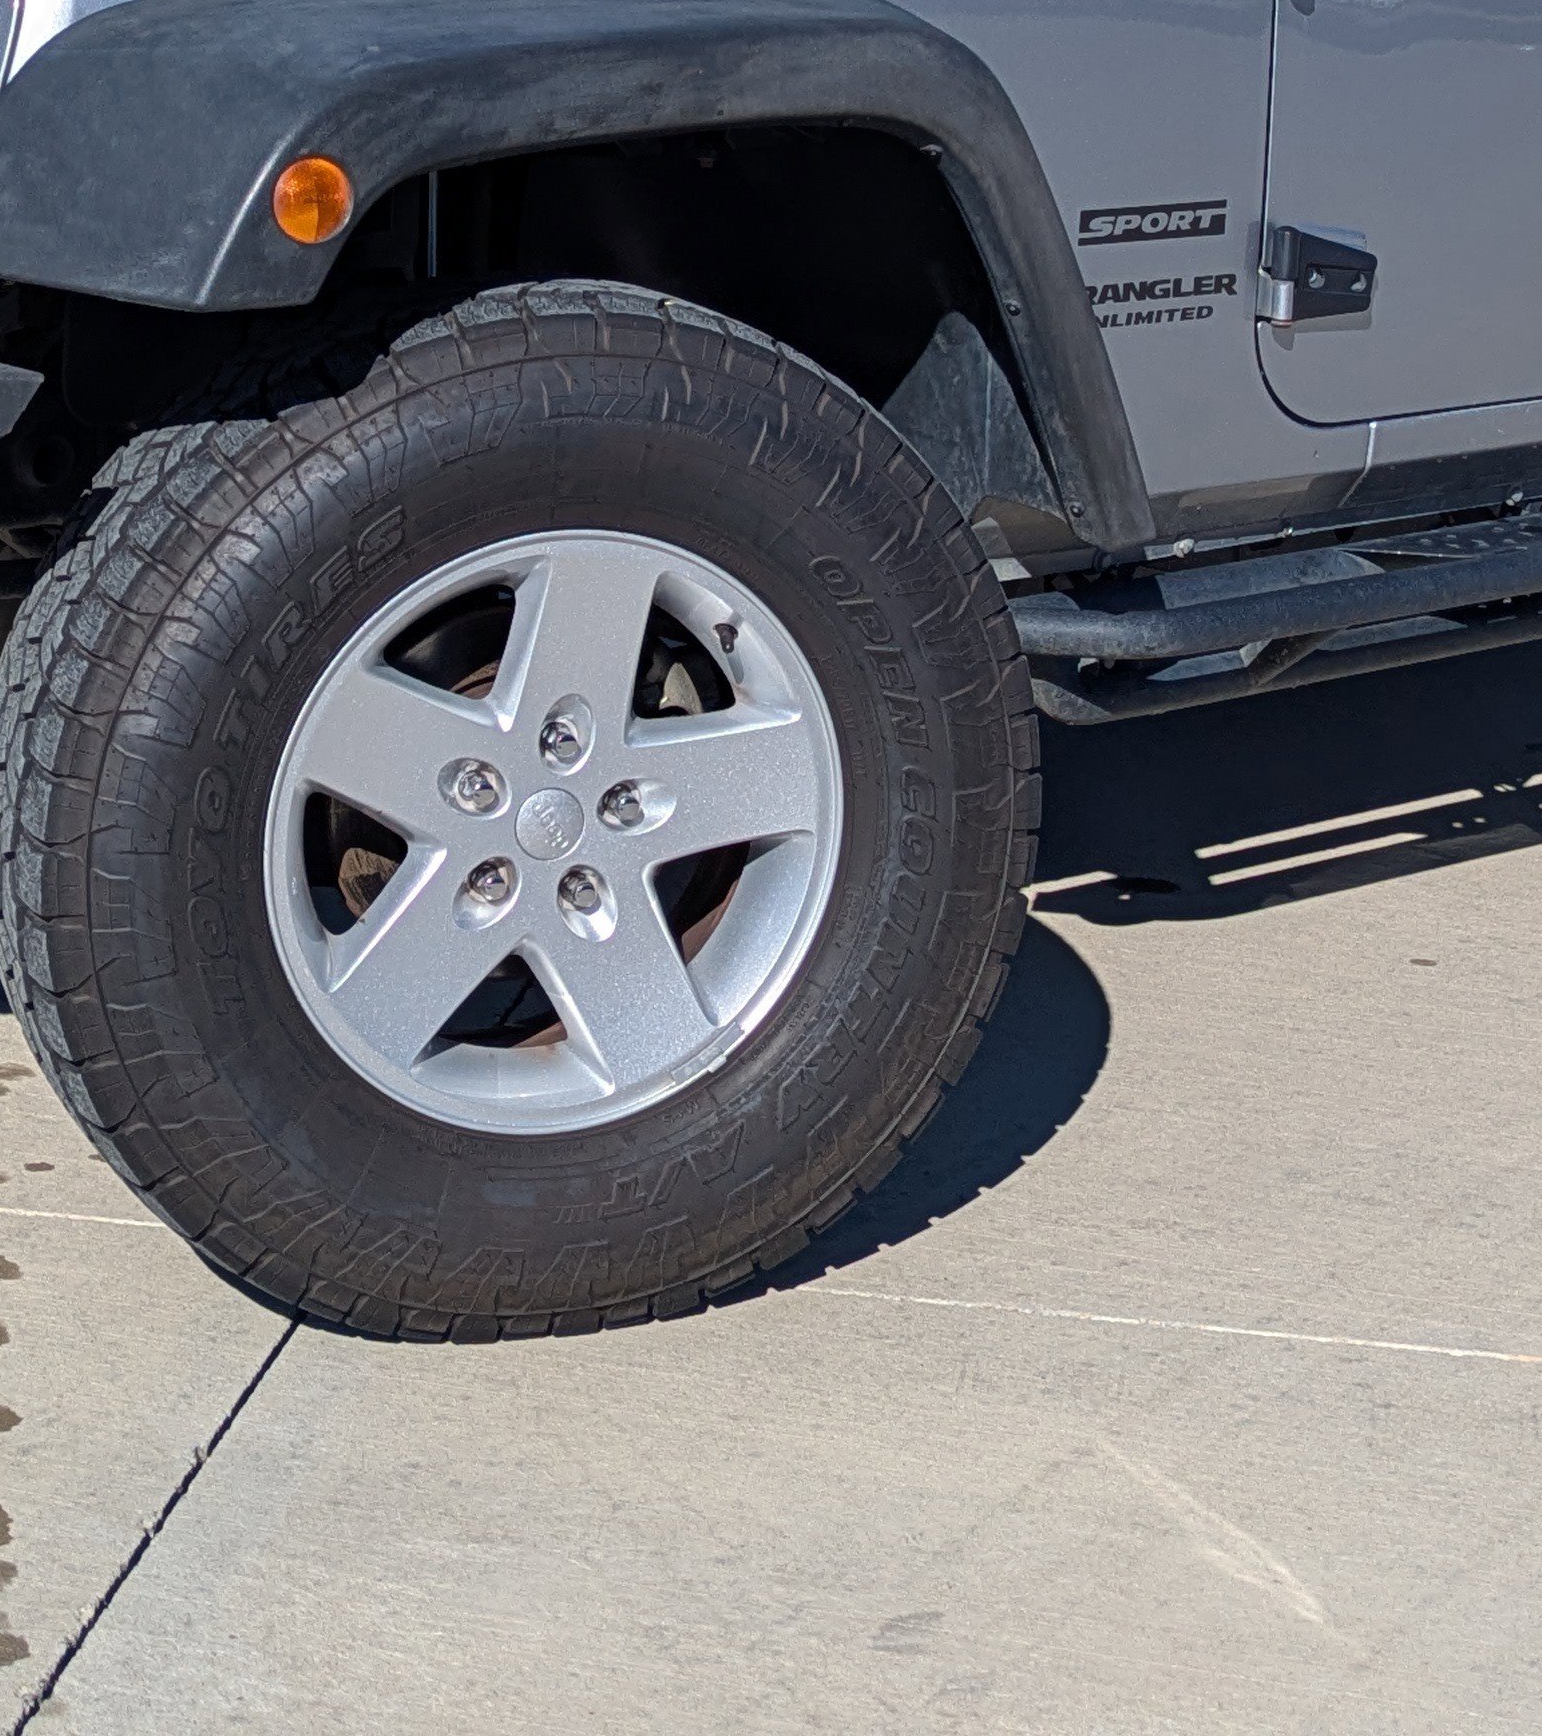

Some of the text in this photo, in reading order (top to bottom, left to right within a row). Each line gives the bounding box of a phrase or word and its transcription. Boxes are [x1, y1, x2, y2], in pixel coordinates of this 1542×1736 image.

[1078, 207, 1228, 240] SPORT
[1085, 273, 1238, 306] RANGLER
[1094, 305, 1214, 329] NLIMITED
[213, 504, 408, 752] TIRES
[808, 553, 931, 751] OPEN
